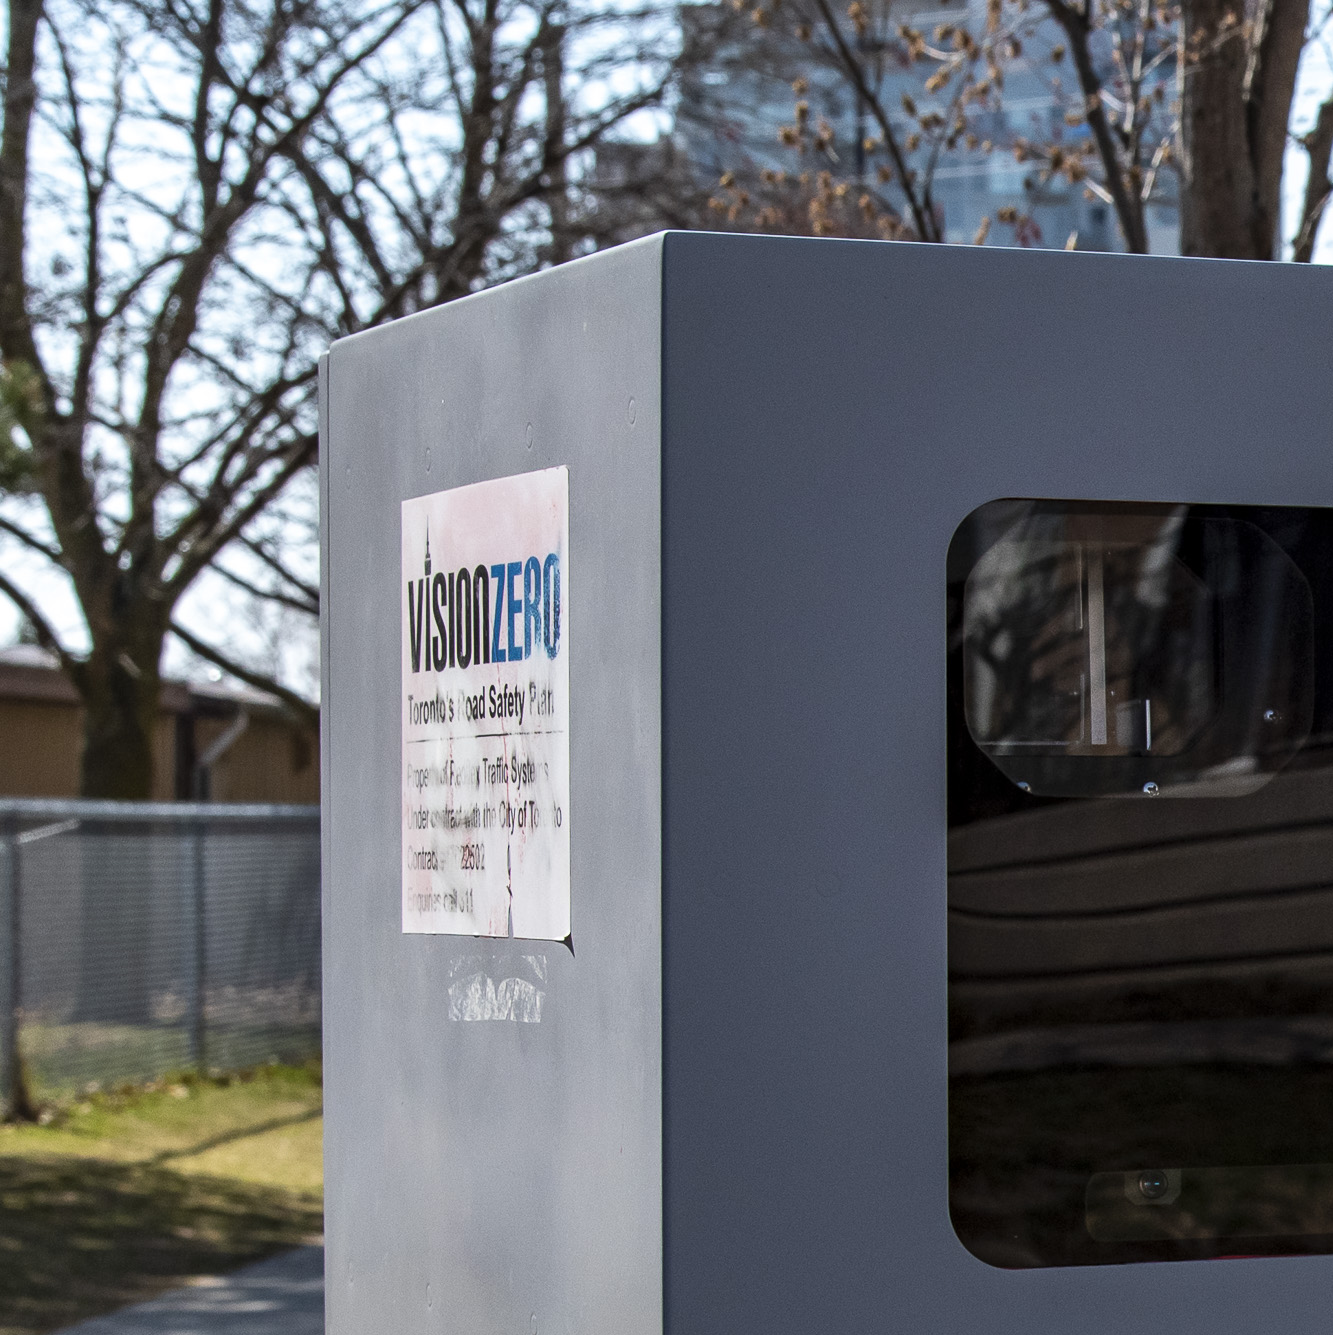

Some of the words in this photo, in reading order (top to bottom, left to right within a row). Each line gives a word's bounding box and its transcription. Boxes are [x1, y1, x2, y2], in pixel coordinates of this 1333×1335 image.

[408, 694, 455, 726] Toronto's
[489, 683, 526, 726] Safety
[529, 681, 556, 716] Plan
[482, 755, 509, 785] Traffic
[511, 755, 549, 790] Systes
[483, 801, 497, 828] the
[500, 799, 516, 835] City
[518, 799, 528, 828] of
[529, 799, 562, 829] Toto
[407, 845, 438, 870] Contrac
